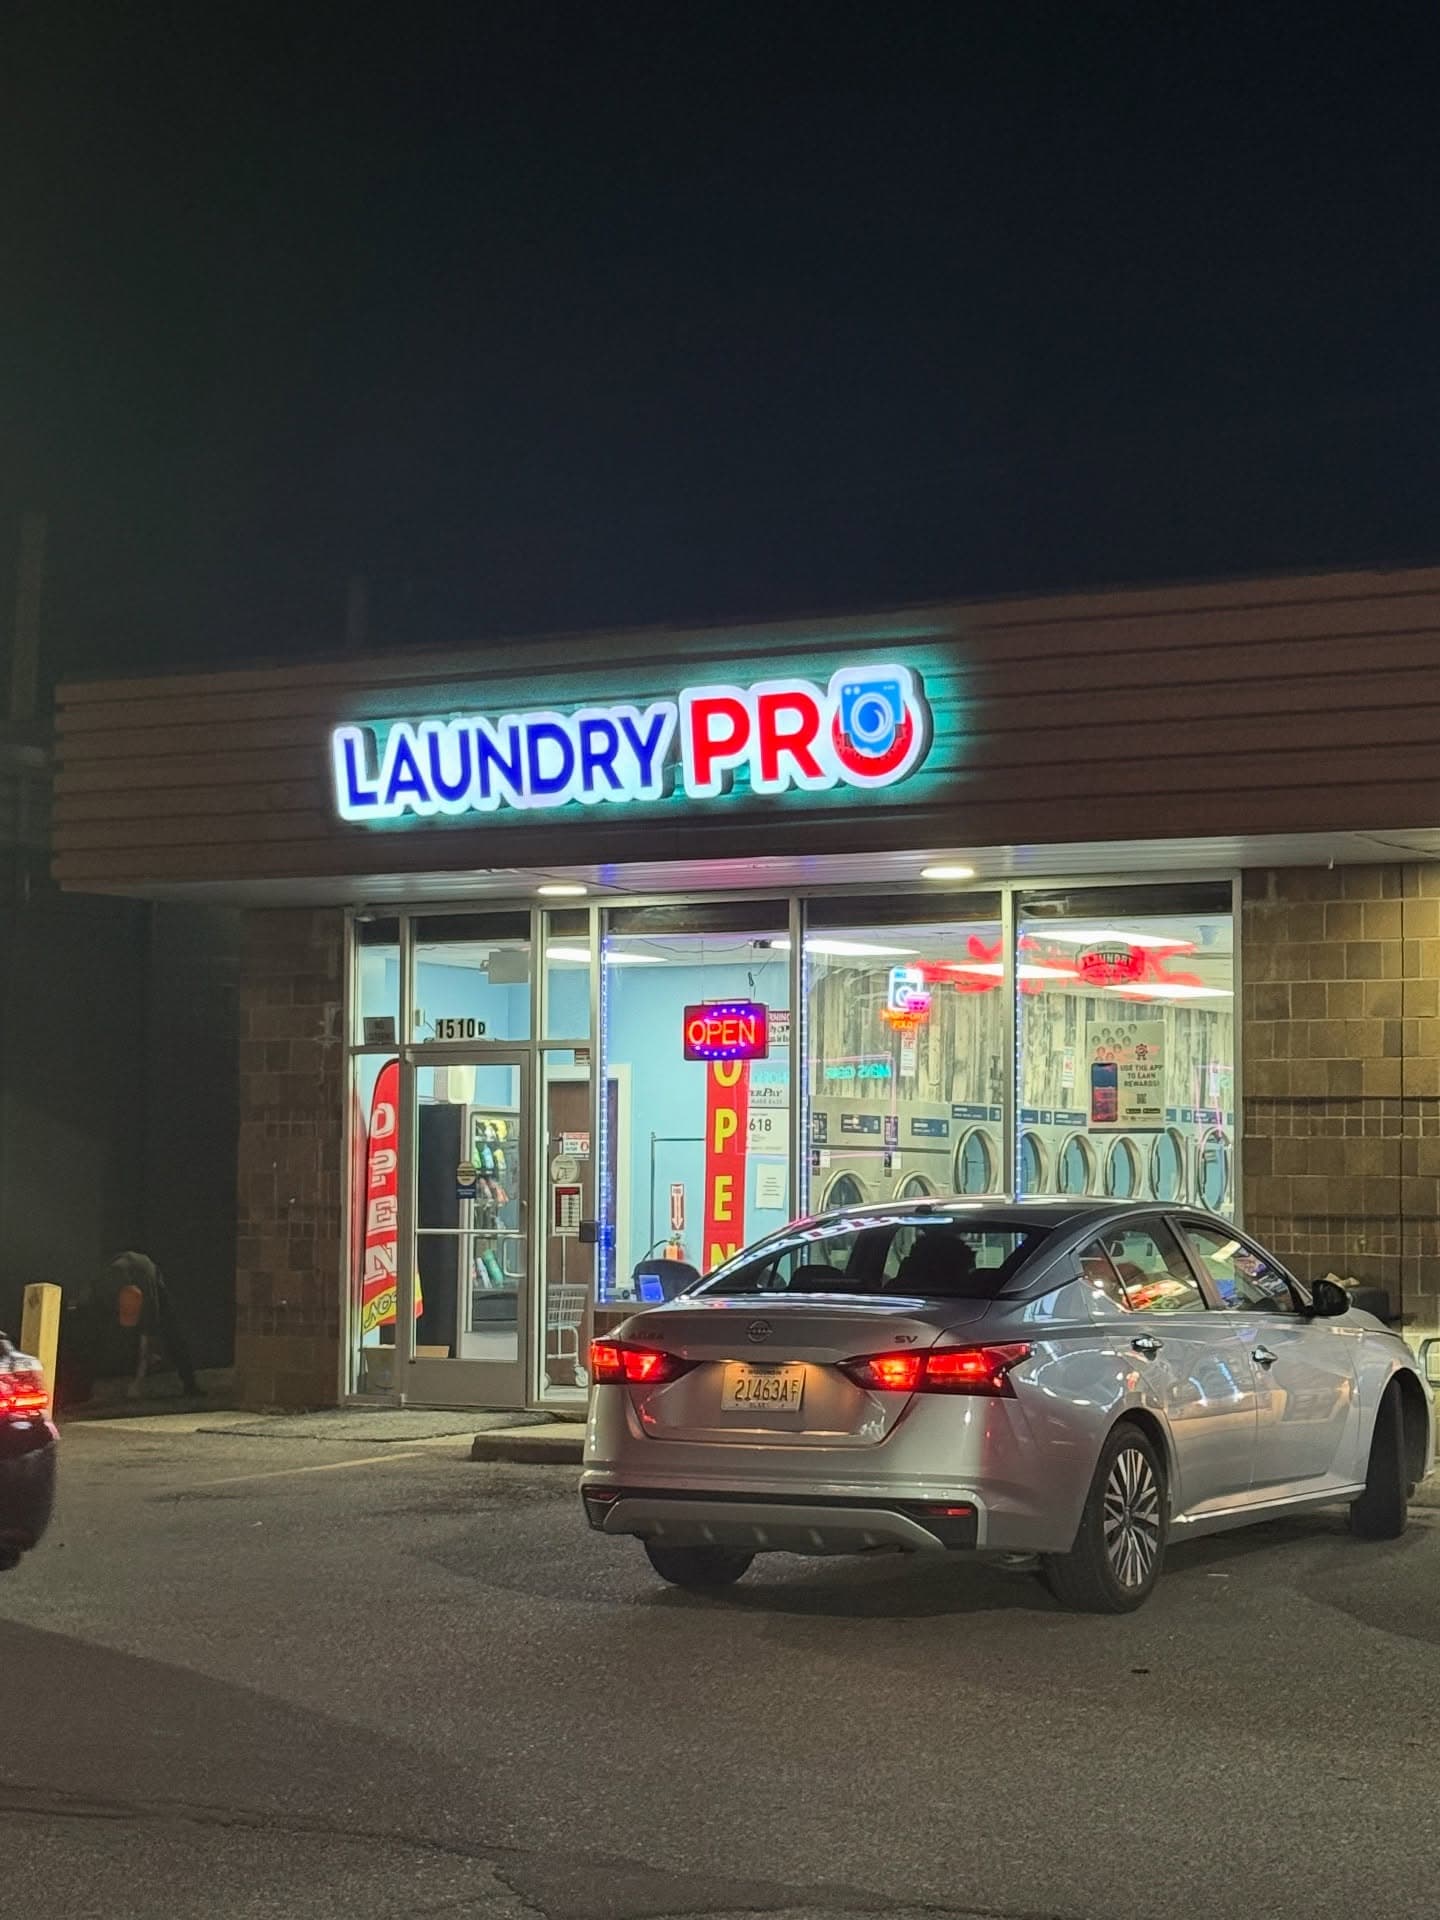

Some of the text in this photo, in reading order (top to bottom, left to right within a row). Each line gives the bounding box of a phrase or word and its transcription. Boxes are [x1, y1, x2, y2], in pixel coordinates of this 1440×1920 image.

[342, 680, 915, 807] LAUNDRY PRO
[688, 1018, 756, 1045] OPEN
[894, 1335, 918, 1344] SV
